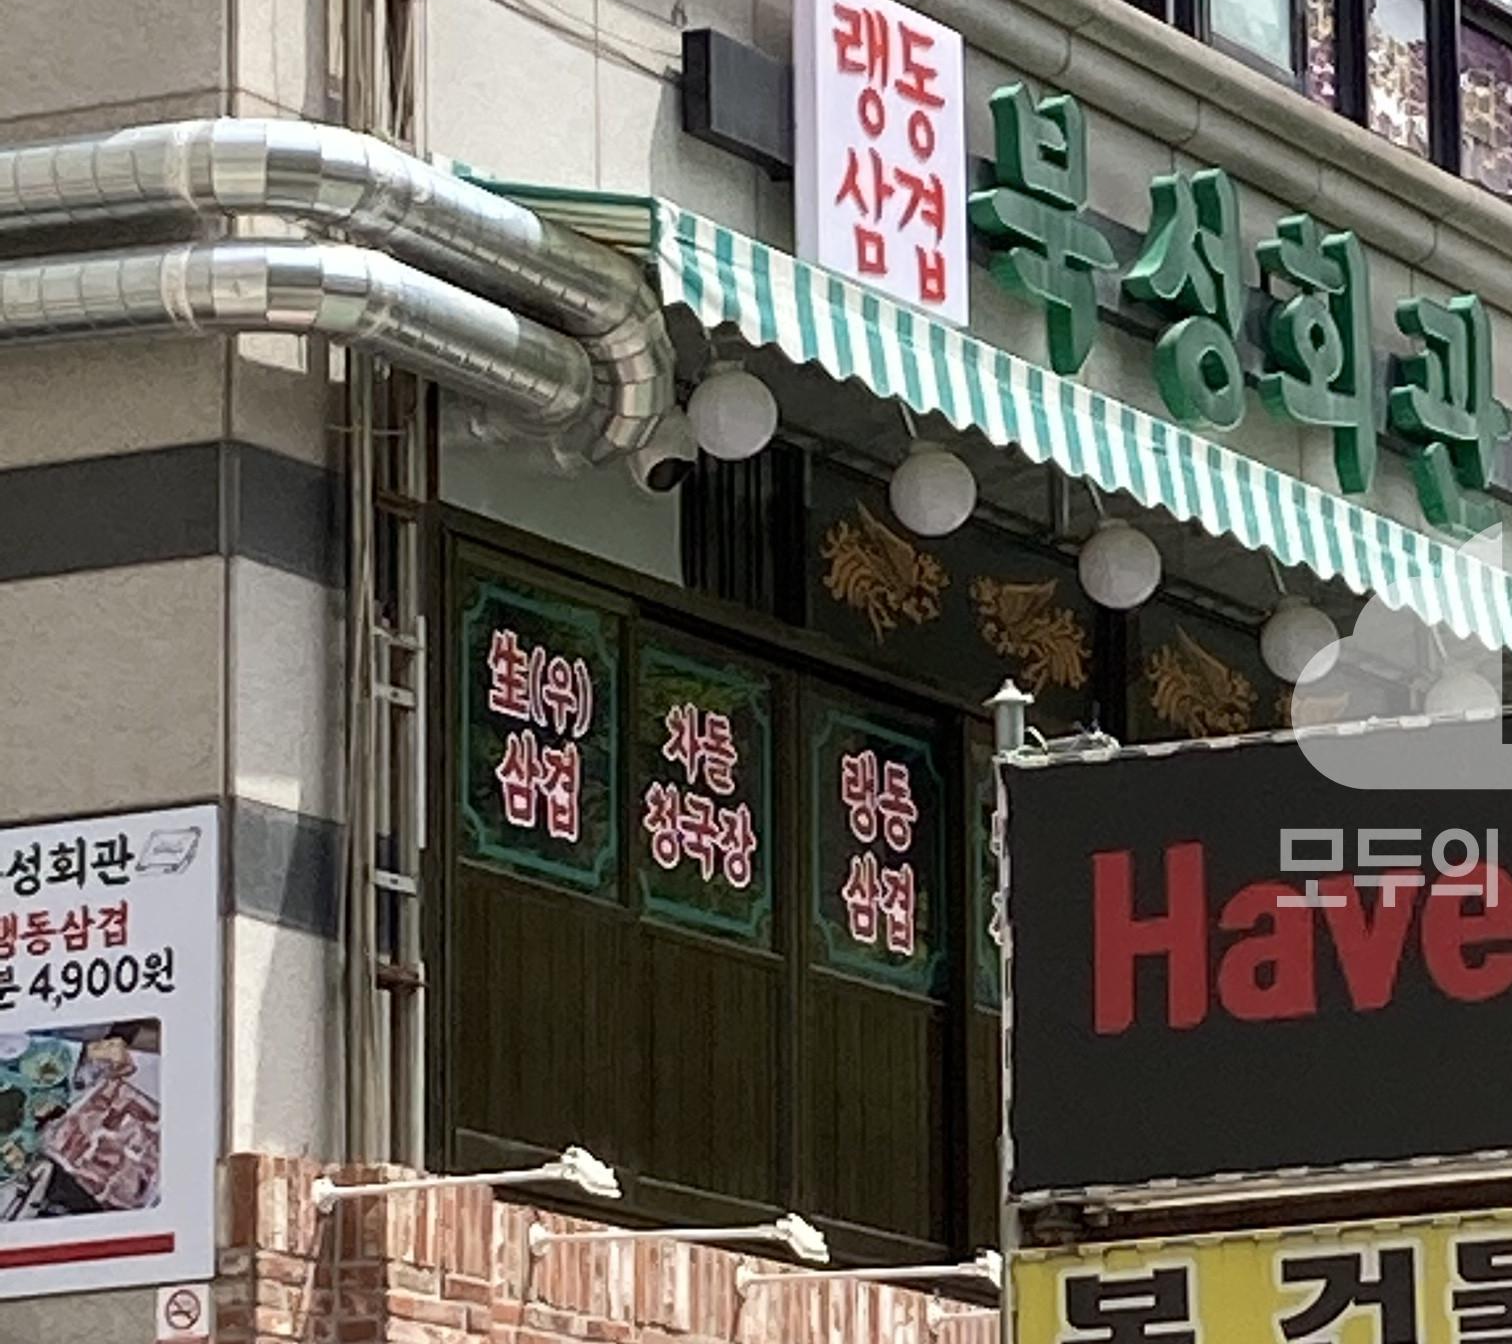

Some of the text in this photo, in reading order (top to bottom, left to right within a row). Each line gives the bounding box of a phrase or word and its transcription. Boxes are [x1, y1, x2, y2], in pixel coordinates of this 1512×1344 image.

[832, 2, 946, 163] 랭동
[835, 147, 946, 304] 삼겹
[968, 81, 1510, 538] 부성회관
[497, 730, 580, 843] 삼겹
[664, 703, 737, 794] 차돌
[0, 832, 135, 896] 성회관
[645, 782, 756, 888] 청국장
[842, 853, 915, 956] 삼겹
[28, 946, 175, 1010] 4,900원
